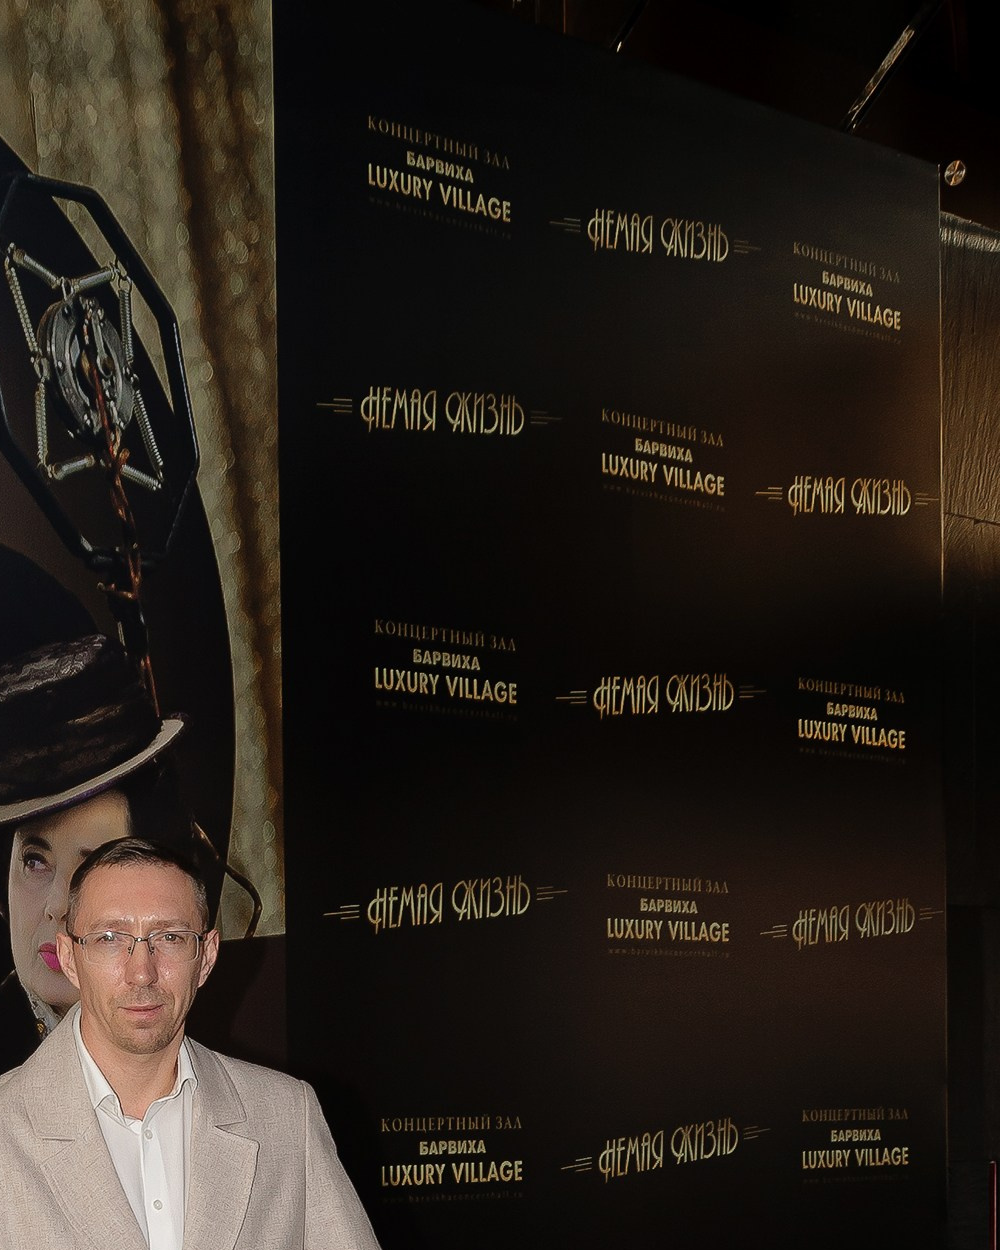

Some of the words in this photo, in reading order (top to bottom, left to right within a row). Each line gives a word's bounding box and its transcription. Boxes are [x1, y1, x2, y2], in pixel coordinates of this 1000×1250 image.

[368, 115, 479, 160] КОНЦЕРТНЫЙ
[484, 144, 511, 170] ЗАЛ
[407, 151, 474, 183] БАРВИХА
[368, 163, 433, 201] LUXURY
[439, 183, 511, 223] VILLAGE
[588, 208, 653, 253] НЕМАЯ
[661, 217, 729, 262] ЖИЗНЬ
[793, 242, 876, 277] КОНЦЕРТНЫЙ
[879, 263, 900, 283] ЗАЛ
[822, 271, 873, 297] БАРВИХА
[793, 282, 842, 315] LUXURY
[846, 297, 901, 331] VILLAGE
[361, 386, 437, 432] НЕМАЯ
[445, 392, 525, 436] ЖИЗНЬ
[602, 408, 697, 441] КОНЦЕРТНЫЙ
[700, 425, 724, 447] ЗАЛ
[634, 437, 693, 463] БАРВИХА
[601, 452, 658, 483] LUXURY
[662, 464, 725, 496] VILLAGE
[788, 475, 845, 516] НЕМАЯ
[851, 477, 912, 516] ЖИЗНЬ
[374, 618, 485, 648] КОНЦЕРТНЫЙ
[489, 634, 517, 652] ЗАЛ
[412, 648, 480, 671] БАРВИХА
[374, 666, 439, 696] LUXURY
[445, 674, 517, 704] VILLAGE
[593, 674, 659, 720] НЕМАЯ
[666, 672, 735, 713] ЖИЗНЬ
[798, 676, 881, 702] КОНЦЕРТНЫЙ
[883, 684, 905, 704] ЗАЛ
[826, 701, 878, 721] БАРВИХА
[797, 718, 846, 742] LUXURY
[850, 725, 906, 750] VILLAGE
[607, 873, 702, 894] КОНЦЕРТНЫЙ
[705, 878, 729, 894] ЗАЛ
[367, 882, 443, 935] НЕМАЯ
[451, 874, 531, 922] ЖИЗНЬ
[639, 897, 699, 914] БАРВИХА
[606, 917, 663, 941] LUXURY
[668, 919, 730, 943] VILLAGE
[792, 904, 849, 951] НЕМАЯ
[855, 897, 915, 939] ЖИЗНЬ
[381, 1113, 491, 1134] КОНЦЕРТНЫЙ
[495, 1115, 522, 1130] ЗАЛ
[802, 1105, 884, 1124] КОНЦЕРТНЫЙ
[886, 1107, 909, 1121] ЗАЛ
[419, 1139, 487, 1156] БАРВИХА
[598, 1129, 664, 1184] НЕМАЯ
[671, 1117, 739, 1165] ЖИЗНЬ
[830, 1128, 881, 1142] БАРВИХА
[381, 1163, 447, 1188] LUXURY
[451, 1160, 523, 1184] VILLAGE
[802, 1149, 851, 1170] LUXURY
[854, 1146, 909, 1167] VILLAGE
